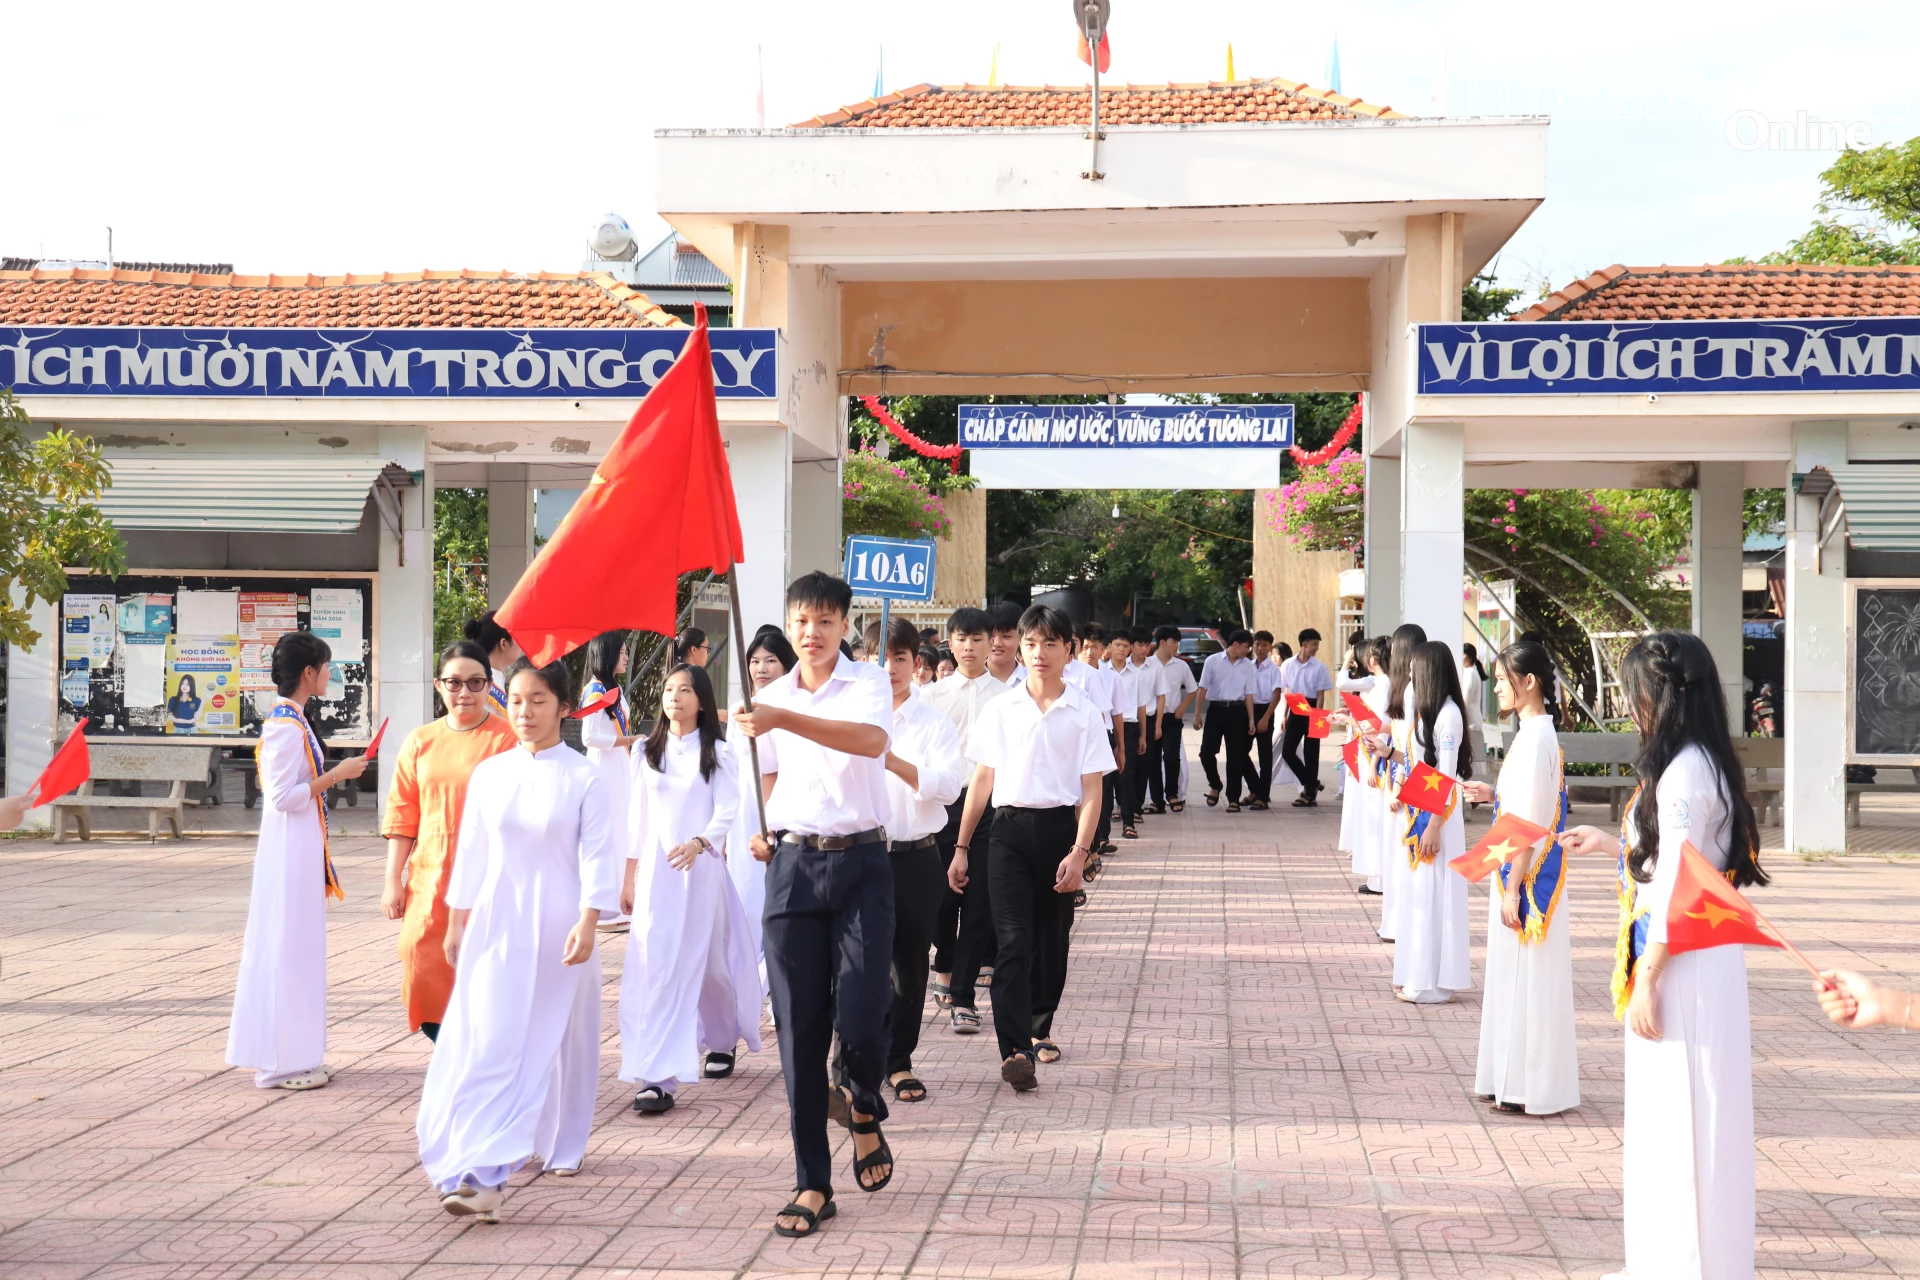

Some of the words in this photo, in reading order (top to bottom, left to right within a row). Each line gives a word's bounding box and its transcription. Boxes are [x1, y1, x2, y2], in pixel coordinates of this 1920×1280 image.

[13, 335, 107, 385] ÍCH
[119, 337, 267, 387] MƯỜI
[281, 342, 409, 388] NĂM
[420, 332, 628, 389] TRỒNG
[639, 348, 764, 388] CY
[1426, 329, 1485, 380] VÌ
[1499, 333, 1590, 387] LỢI
[1604, 327, 1695, 380] ÍCH
[1708, 328, 1887, 379] TRĂM
[964, 407, 1006, 442] CHẮP
[1008, 412, 1050, 442] CÁNH
[1050, 415, 1079, 442] MƠ
[1117, 412, 1162, 442] VỮNG
[1163, 411, 1207, 442] BƯỚC
[1208, 414, 1262, 442] TƯƠNG
[1262, 418, 1288, 442] LAI
[853, 550, 930, 586] 10A6
